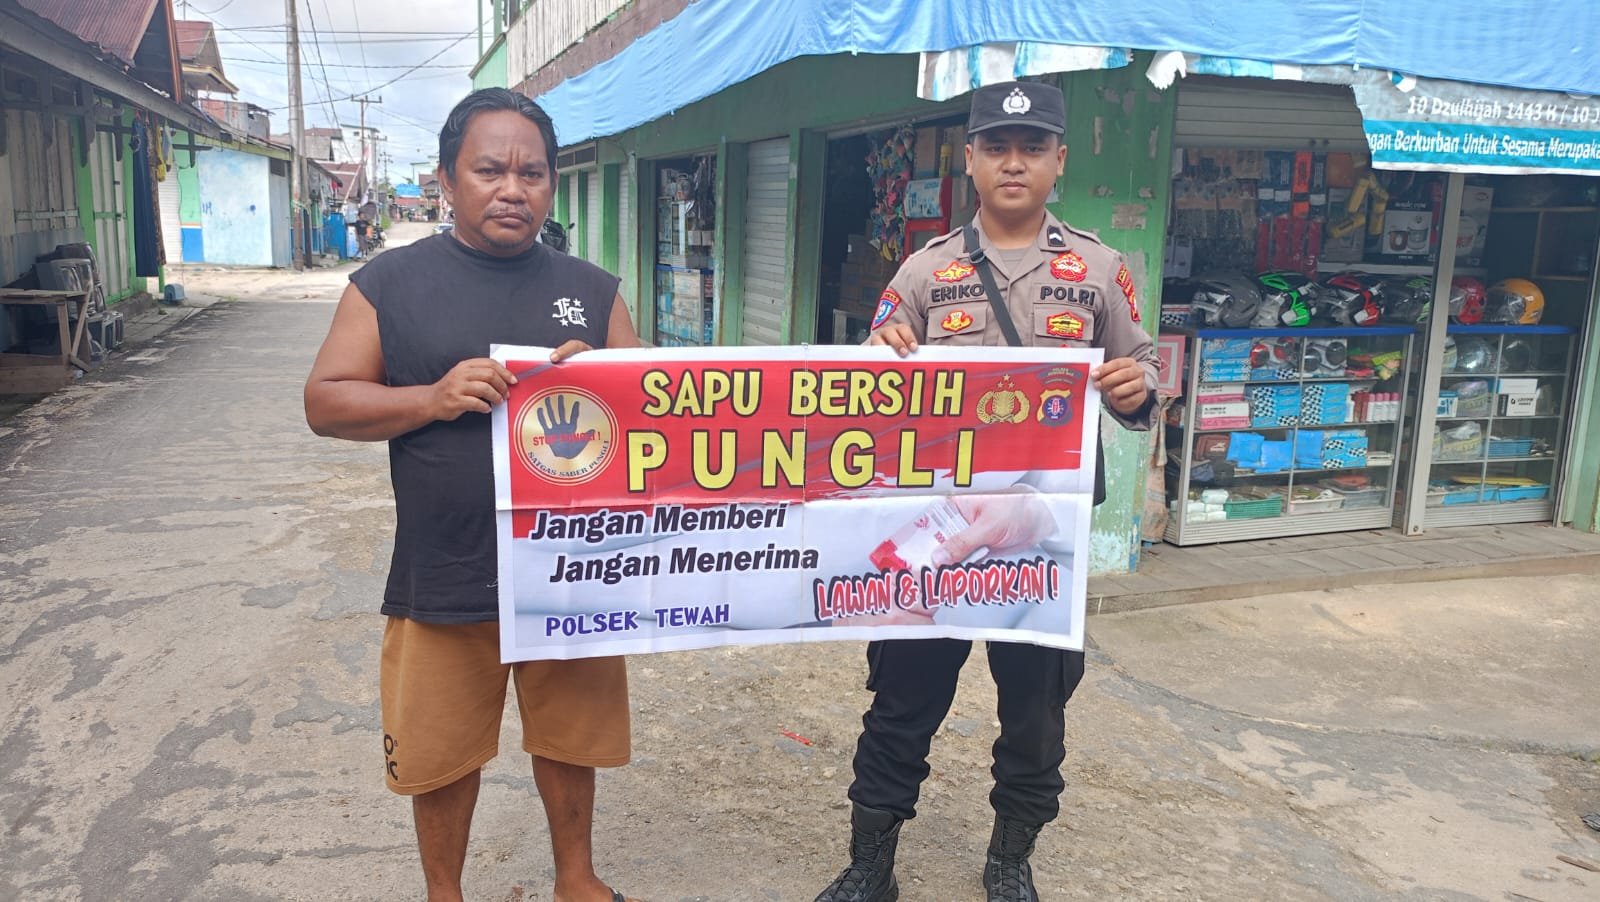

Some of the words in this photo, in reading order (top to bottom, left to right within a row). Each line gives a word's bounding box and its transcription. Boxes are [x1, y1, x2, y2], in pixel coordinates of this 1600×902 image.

[1407, 95, 1427, 115] 10
[1431, 95, 1502, 122] Dzulhijah
[1506, 102, 1542, 121] 1443
[1572, 106, 1590, 124] 10
[1394, 129, 1460, 154] Berkurban
[1463, 133, 1498, 155] Untuk
[1500, 135, 1545, 158] Sesama
[930, 283, 985, 303] ERIKO
[1040, 286, 1096, 307] POLRI
[641, 369, 763, 418] SAPU
[789, 369, 965, 417] BERSIH
[559, 467, 588, 478] SABER
[589, 440, 610, 470] PUNGLI
[626, 427, 976, 493] PUNGLI
[531, 510, 645, 543] Jangan
[653, 503, 787, 534] Memberi
[550, 554, 660, 585] Jangan
[670, 543, 819, 574] Menerima
[813, 568, 892, 622] LAWAN
[897, 568, 920, 610] &
[545, 611, 638, 637] POLSEK
[655, 604, 730, 629] TEWAH
